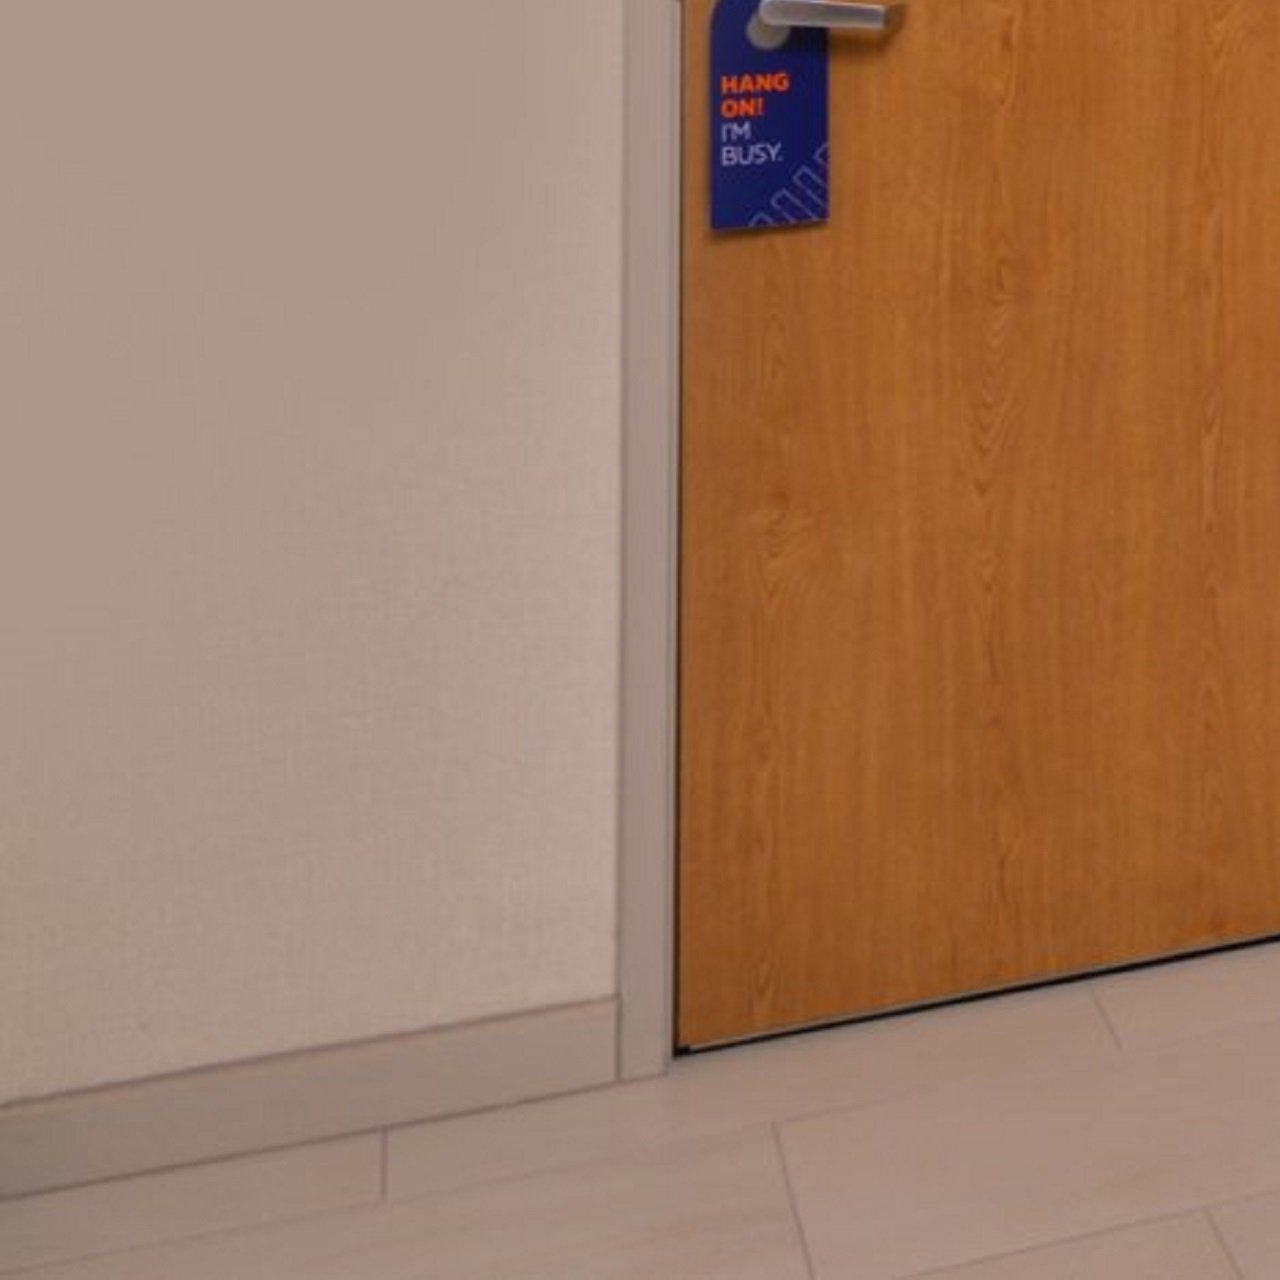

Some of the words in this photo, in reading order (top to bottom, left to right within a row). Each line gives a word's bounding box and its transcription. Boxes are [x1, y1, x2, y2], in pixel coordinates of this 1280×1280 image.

[721, 73, 790, 94] HANG
[721, 97, 764, 118] ON!
[722, 121, 752, 142] I'M
[722, 142, 784, 166] BUSY.
